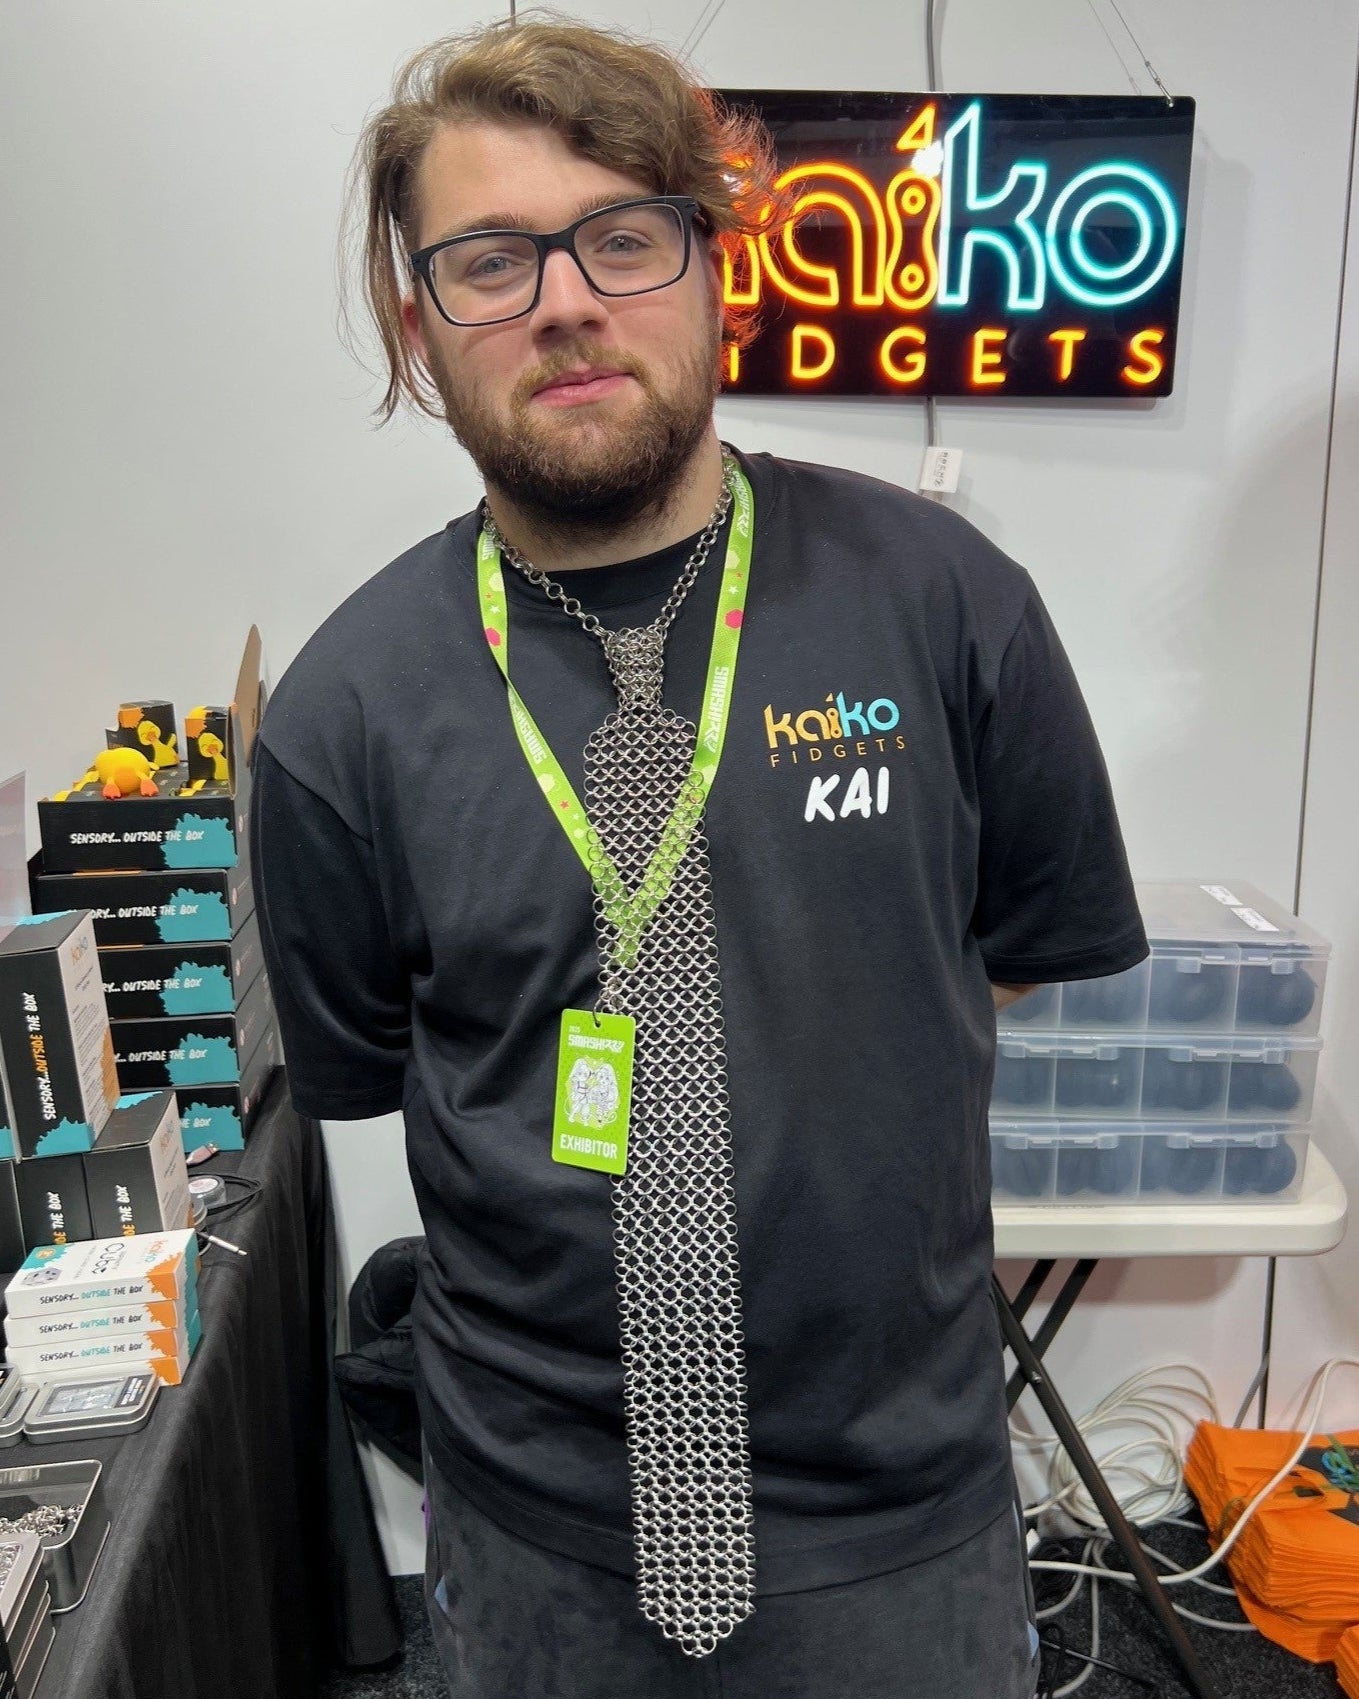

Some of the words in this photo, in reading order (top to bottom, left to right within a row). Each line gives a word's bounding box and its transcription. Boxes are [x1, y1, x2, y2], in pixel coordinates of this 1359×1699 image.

[729, 326, 1164, 385] IDGETS
[764, 691, 900, 749] kaiko
[770, 735, 905, 768] FIDGETS
[804, 766, 890, 822] KAI
[70, 831, 121, 844] SENSORY...
[123, 830, 162, 843] OUTSIDE
[164, 829, 182, 841] THE
[185, 829, 205, 841] BOX
[118, 906, 157, 918] OUTSIDE
[159, 904, 177, 916] THE
[180, 904, 199, 915] BOX
[122, 979, 161, 992] OUTSIDE
[164, 978, 181, 990] THE
[184, 978, 203, 989] BOX
[22, 991, 39, 1012] BOX
[26, 1014, 41, 1032] THE
[29, 1033, 49, 1074] OUTSIDE
[128, 1050, 167, 1062] OUTSIDE
[169, 1049, 186, 1060] THE
[188, 1048, 208, 1059] BOX
[180, 1117, 190, 1129] HE
[193, 1117, 212, 1129] BOX
[559, 1133, 619, 1160] EXHIBITOR
[46, 1191, 62, 1211] BOX
[115, 1184, 131, 1204] BOX
[50, 1212, 65, 1230] THE
[118, 1205, 134, 1223] THE
[81, 1288, 112, 1300] OUTSIDE
[113, 1286, 127, 1296] THE
[129, 1285, 144, 1294] BOX
[80, 1317, 111, 1329] OUTSIDE
[112, 1315, 126, 1325] THE
[128, 1314, 143, 1324] BOX
[81, 1345, 111, 1357] OUTSIDE
[113, 1344, 127, 1353] THE
[129, 1342, 144, 1352] BOX
